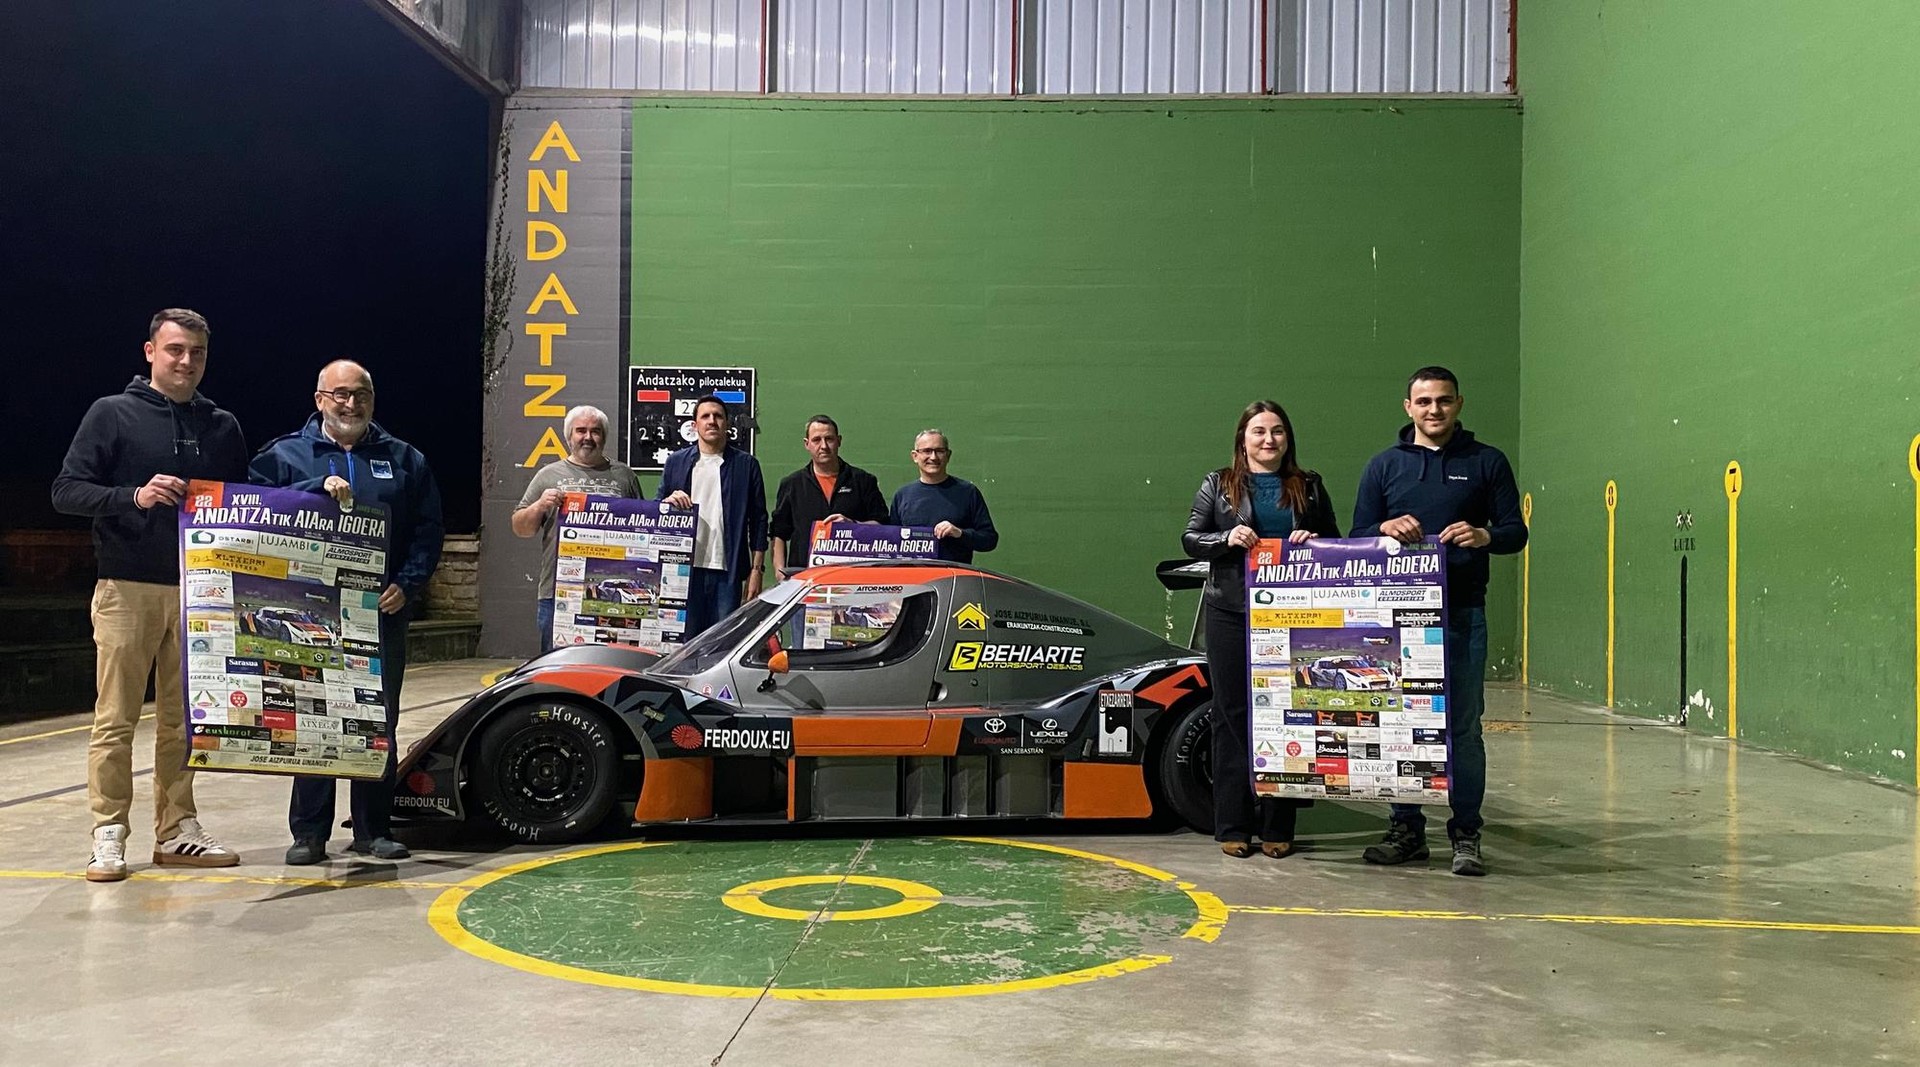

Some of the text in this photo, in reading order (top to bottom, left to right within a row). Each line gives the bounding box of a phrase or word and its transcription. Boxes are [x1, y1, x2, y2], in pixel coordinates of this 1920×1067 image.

[637, 374, 746, 388] Andatzako pilotalekua
[195, 495, 213, 508] 22
[231, 494, 262, 505] XVIII.
[1608, 485, 1614, 506] 8
[337, 514, 385, 538] IGOERA
[657, 515, 694, 529] IGOERA
[899, 540, 934, 553] IGOERA
[1673, 537, 1696, 552] LUZE
[328, 547, 372, 559] ALMOSPORT
[1257, 551, 1273, 564] 22
[1288, 549, 1313, 562] XVIII.
[1386, 554, 1440, 576] IGOERA
[994, 609, 1012, 619] JOSE
[1014, 610, 1048, 621] AIZPURUA
[981, 644, 1085, 664] BEHIARTE
[978, 661, 1045, 670] MOTORSPORT
[1100, 693, 1133, 708] ETXEZARRETA
[704, 728, 791, 750] FERDOUX.EU
[1029, 730, 1069, 738] LEXUS
[1000, 746, 1044, 755] SAN SEBASTIÁN
[250, 755, 268, 763] JOSE
[269, 756, 301, 765] AIZPURUA
[393, 796, 450, 808] FERDOUX.EU
